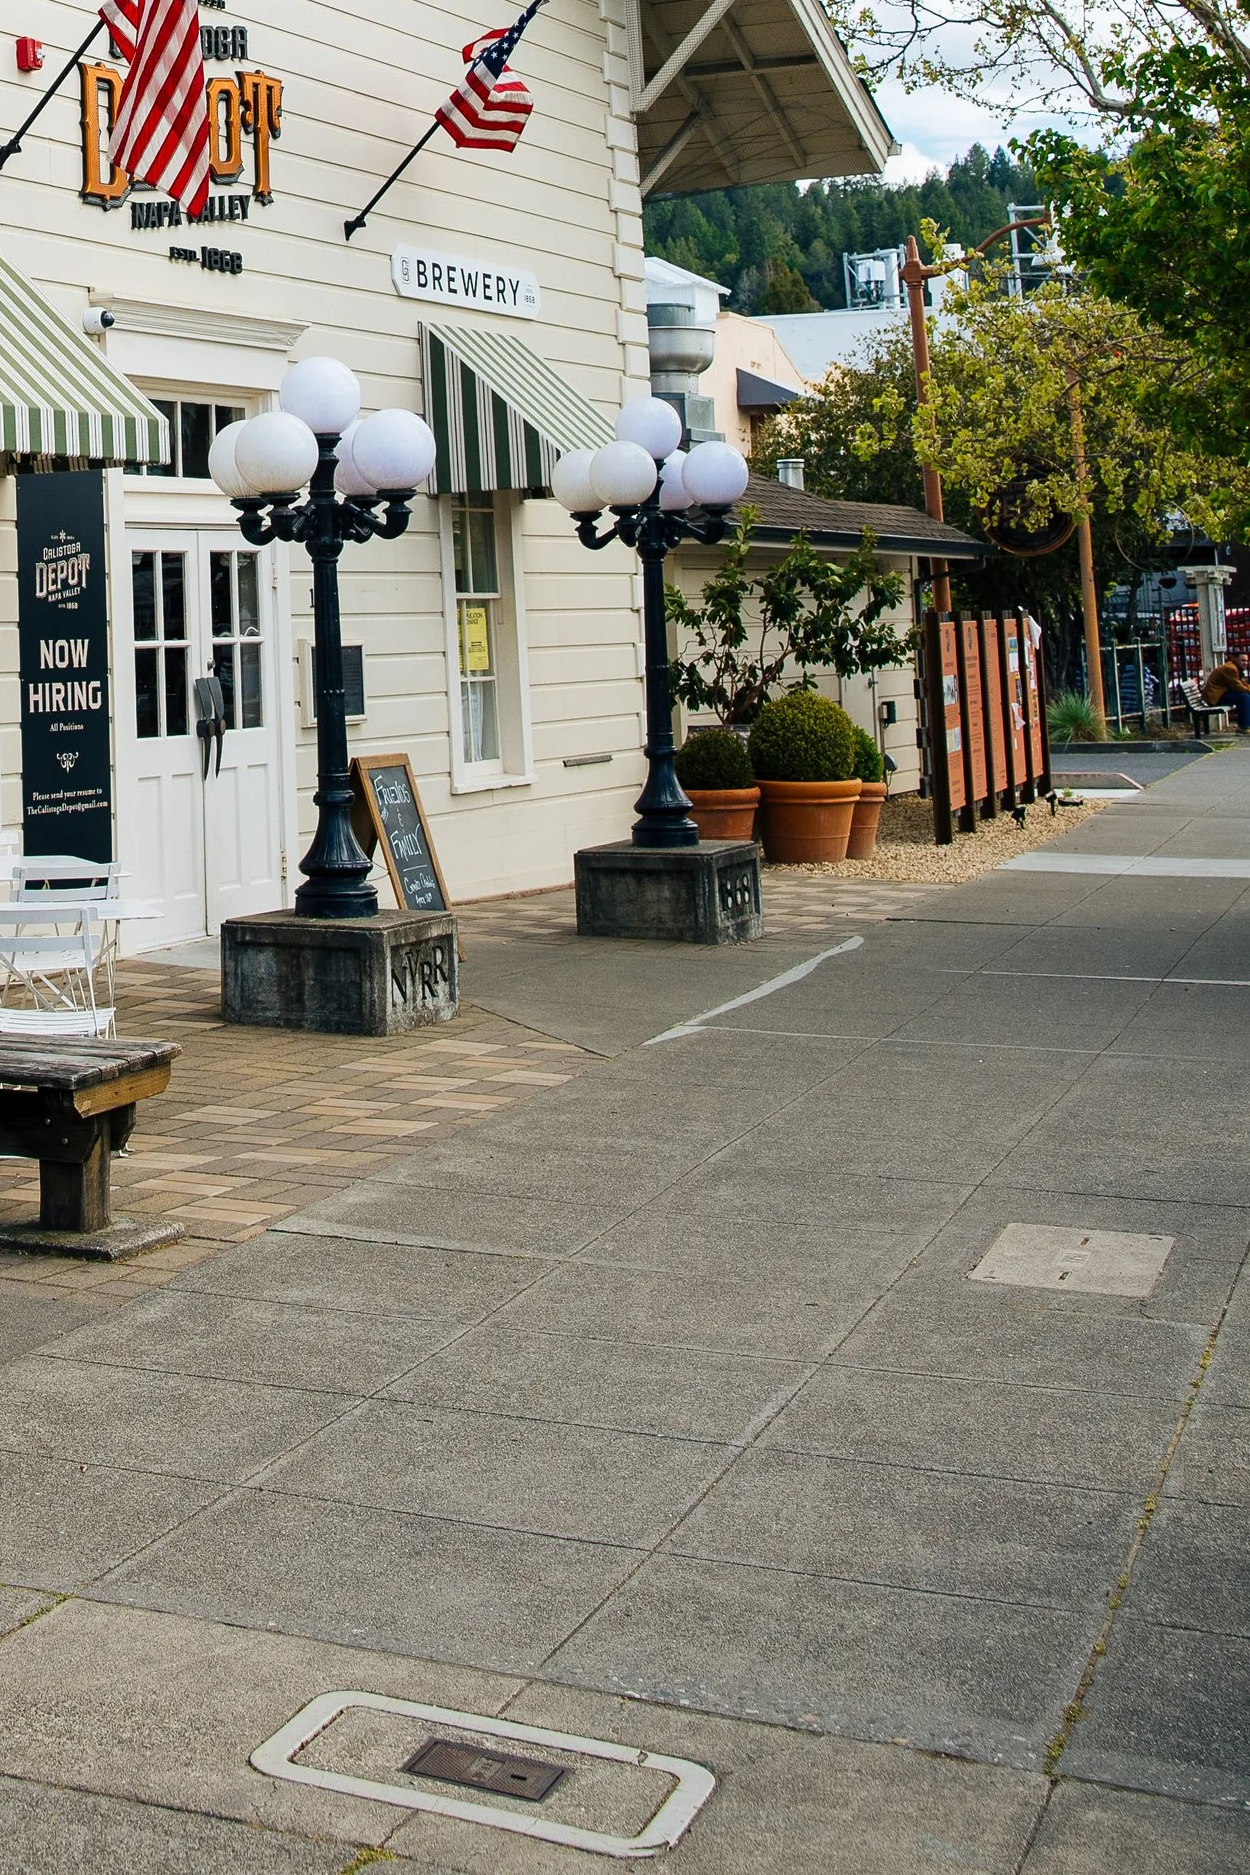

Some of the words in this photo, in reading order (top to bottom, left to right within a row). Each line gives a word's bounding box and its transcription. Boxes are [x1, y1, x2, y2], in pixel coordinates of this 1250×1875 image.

[77, 61, 284, 211] DOT
[131, 201, 182, 230] NAPA
[187, 195, 252, 225] ALLEY
[200, 246, 243, 275] 1868
[416, 259, 520, 307] BREWERY
[42, 541, 81, 561] CALISTOGA
[35, 552, 91, 599] DEPOT
[48, 591, 62, 603] NAPA
[62, 586, 81, 599] VALLEY
[39, 638, 90, 670] NOW
[28, 680, 102, 714] HIRING
[49, 722, 58, 732] All
[59, 722, 84, 731] Positions
[32, 791, 50, 801] Please
[50, 789, 63, 800] send
[63, 790, 77, 801] your
[76, 789, 96, 798] resume
[96, 787, 103, 795] to
[373, 774, 411, 806] FRIENDS
[26, 800, 109, 816] TheCalistogaDepot@gmail.com
[390, 823, 423, 862] FAMILY
[390, 945, 449, 1007] NVRR
